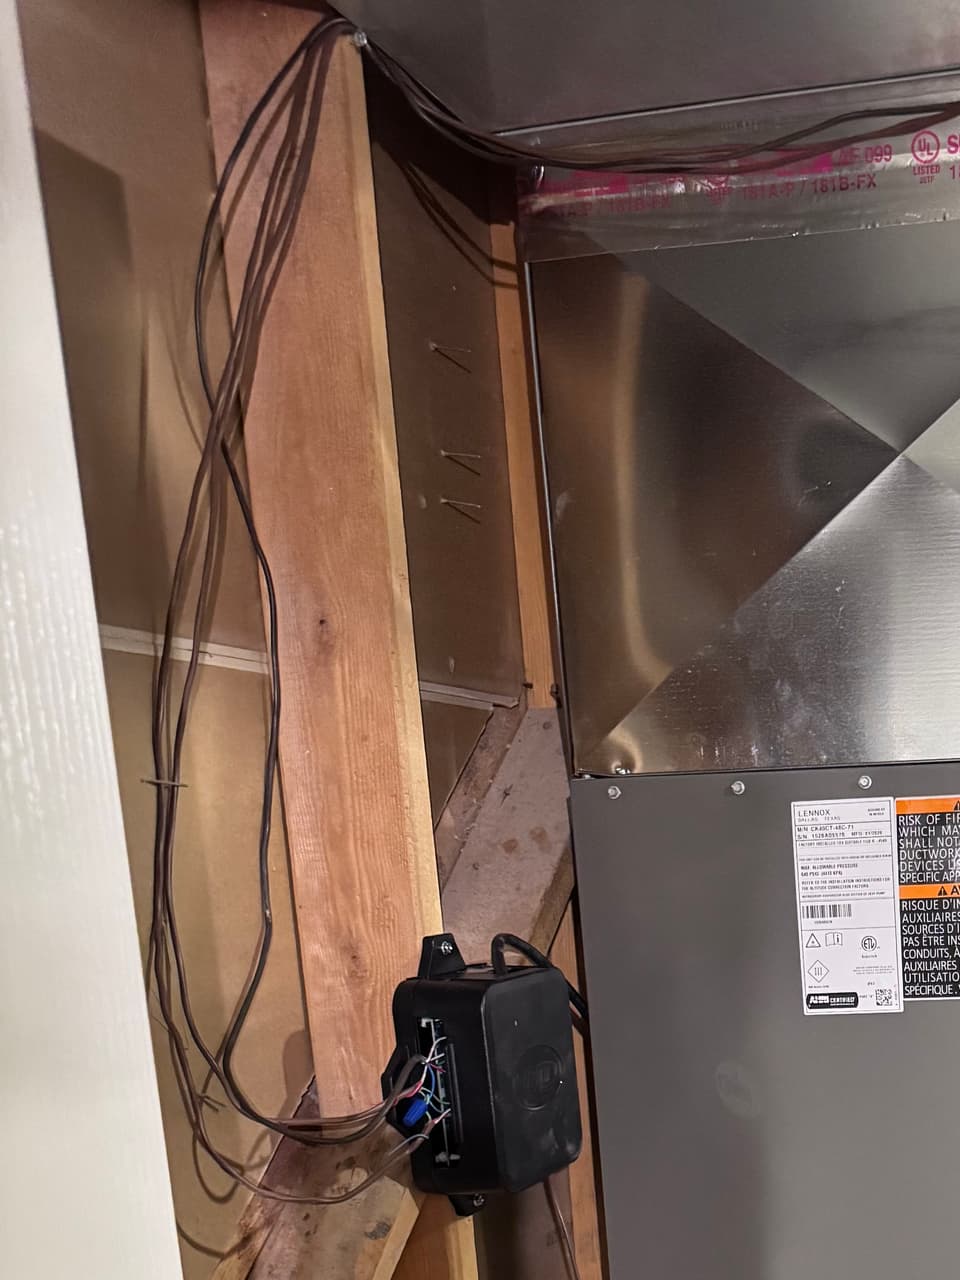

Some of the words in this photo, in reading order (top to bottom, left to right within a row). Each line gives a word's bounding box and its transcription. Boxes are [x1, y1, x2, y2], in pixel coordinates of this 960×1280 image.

[912, 166, 940, 176] LISTED
[798, 809, 830, 817] LENNOX
[898, 815, 921, 826] RISK
[926, 815, 940, 824] OF
[898, 826, 936, 837] WHICH
[899, 838, 933, 849] SHALL
[937, 837, 959, 847] NOT
[900, 860, 944, 872] DEVICES
[900, 871, 940, 883] SPECIFIC
